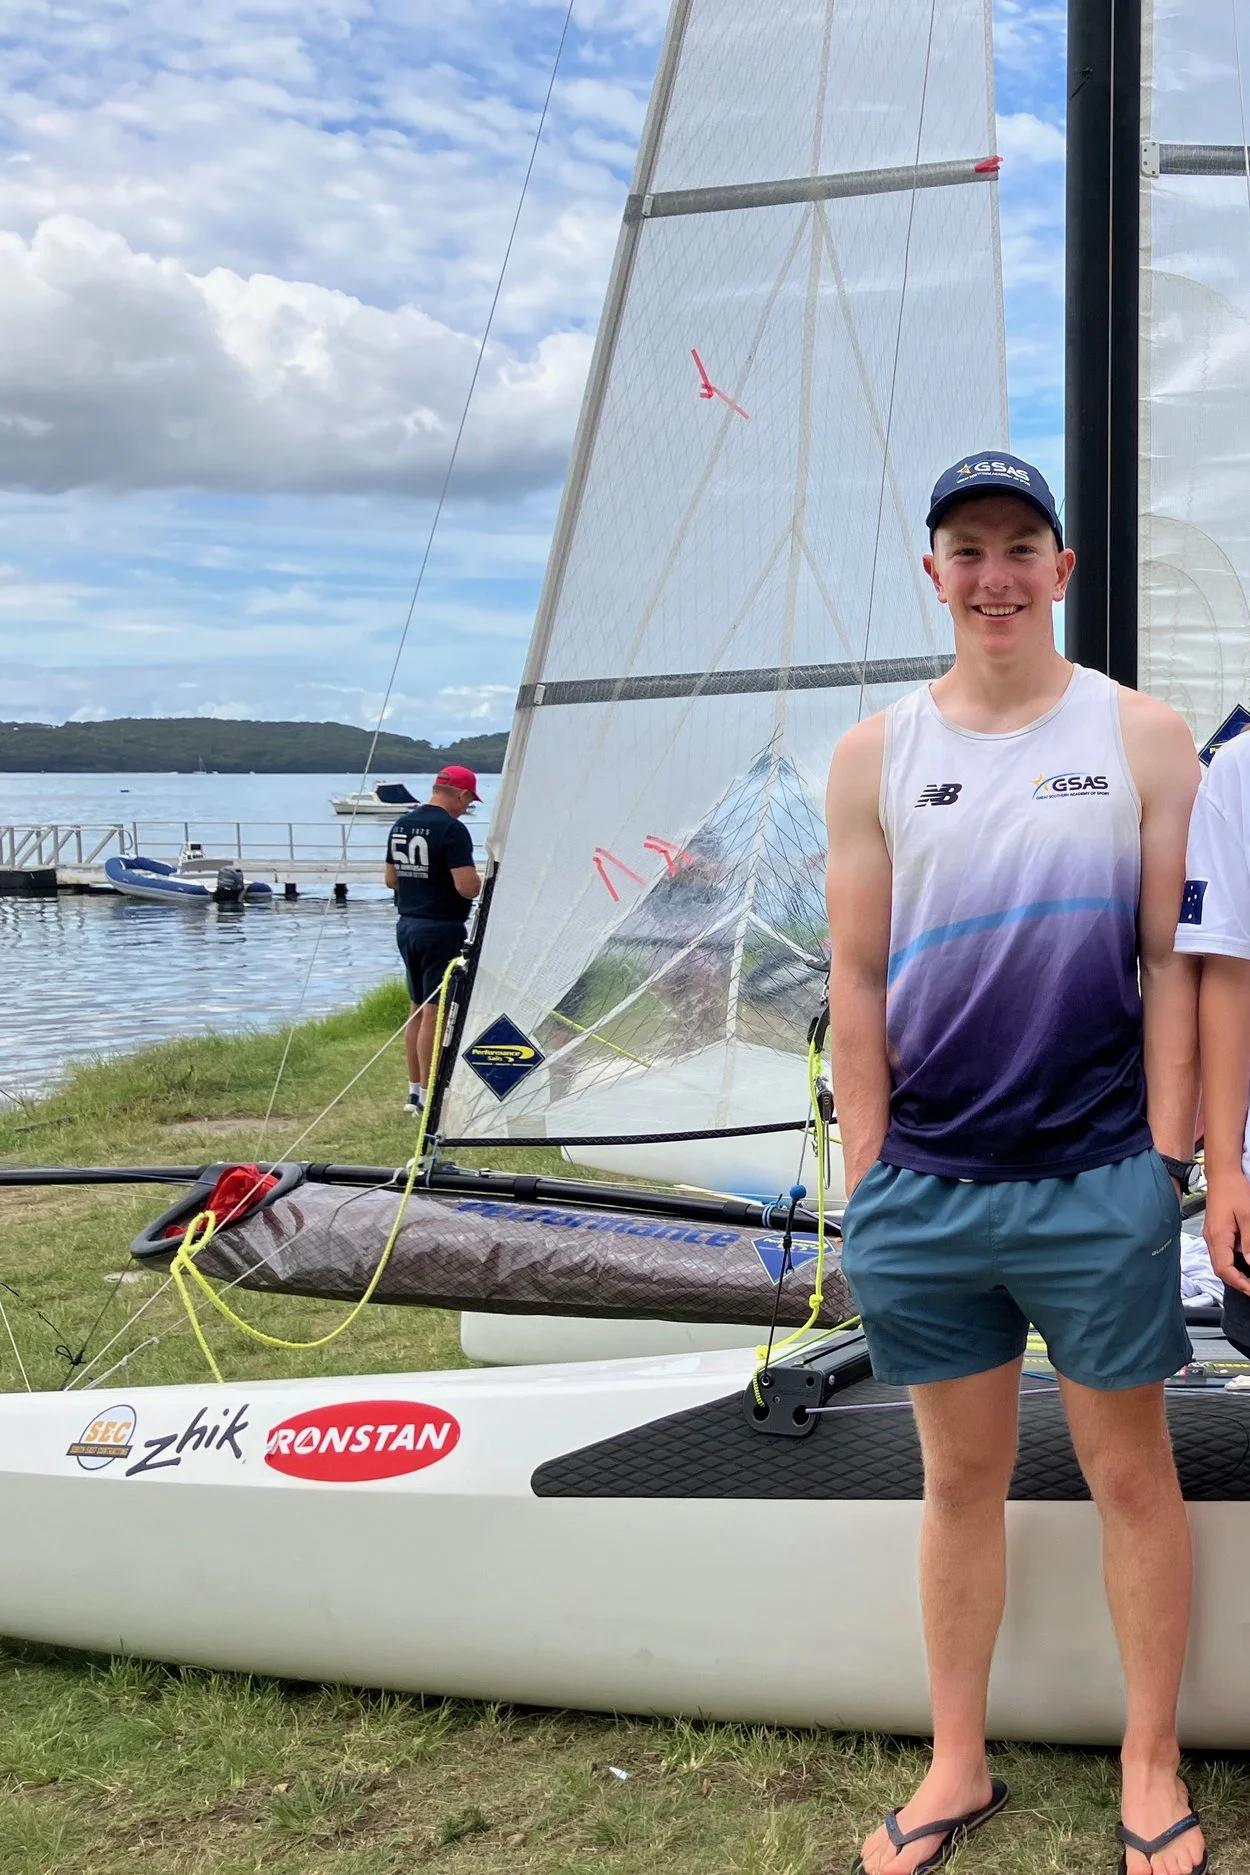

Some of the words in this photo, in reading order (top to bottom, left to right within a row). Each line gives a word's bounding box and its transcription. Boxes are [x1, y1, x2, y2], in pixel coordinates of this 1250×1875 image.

[973, 461, 1031, 482] GSAS
[1051, 775, 1109, 792] GSAS
[472, 1049, 521, 1057] Performance
[457, 1201, 742, 1248] Performance
[84, 1419, 132, 1444] SEC
[271, 1421, 452, 1456] RONSTAN
